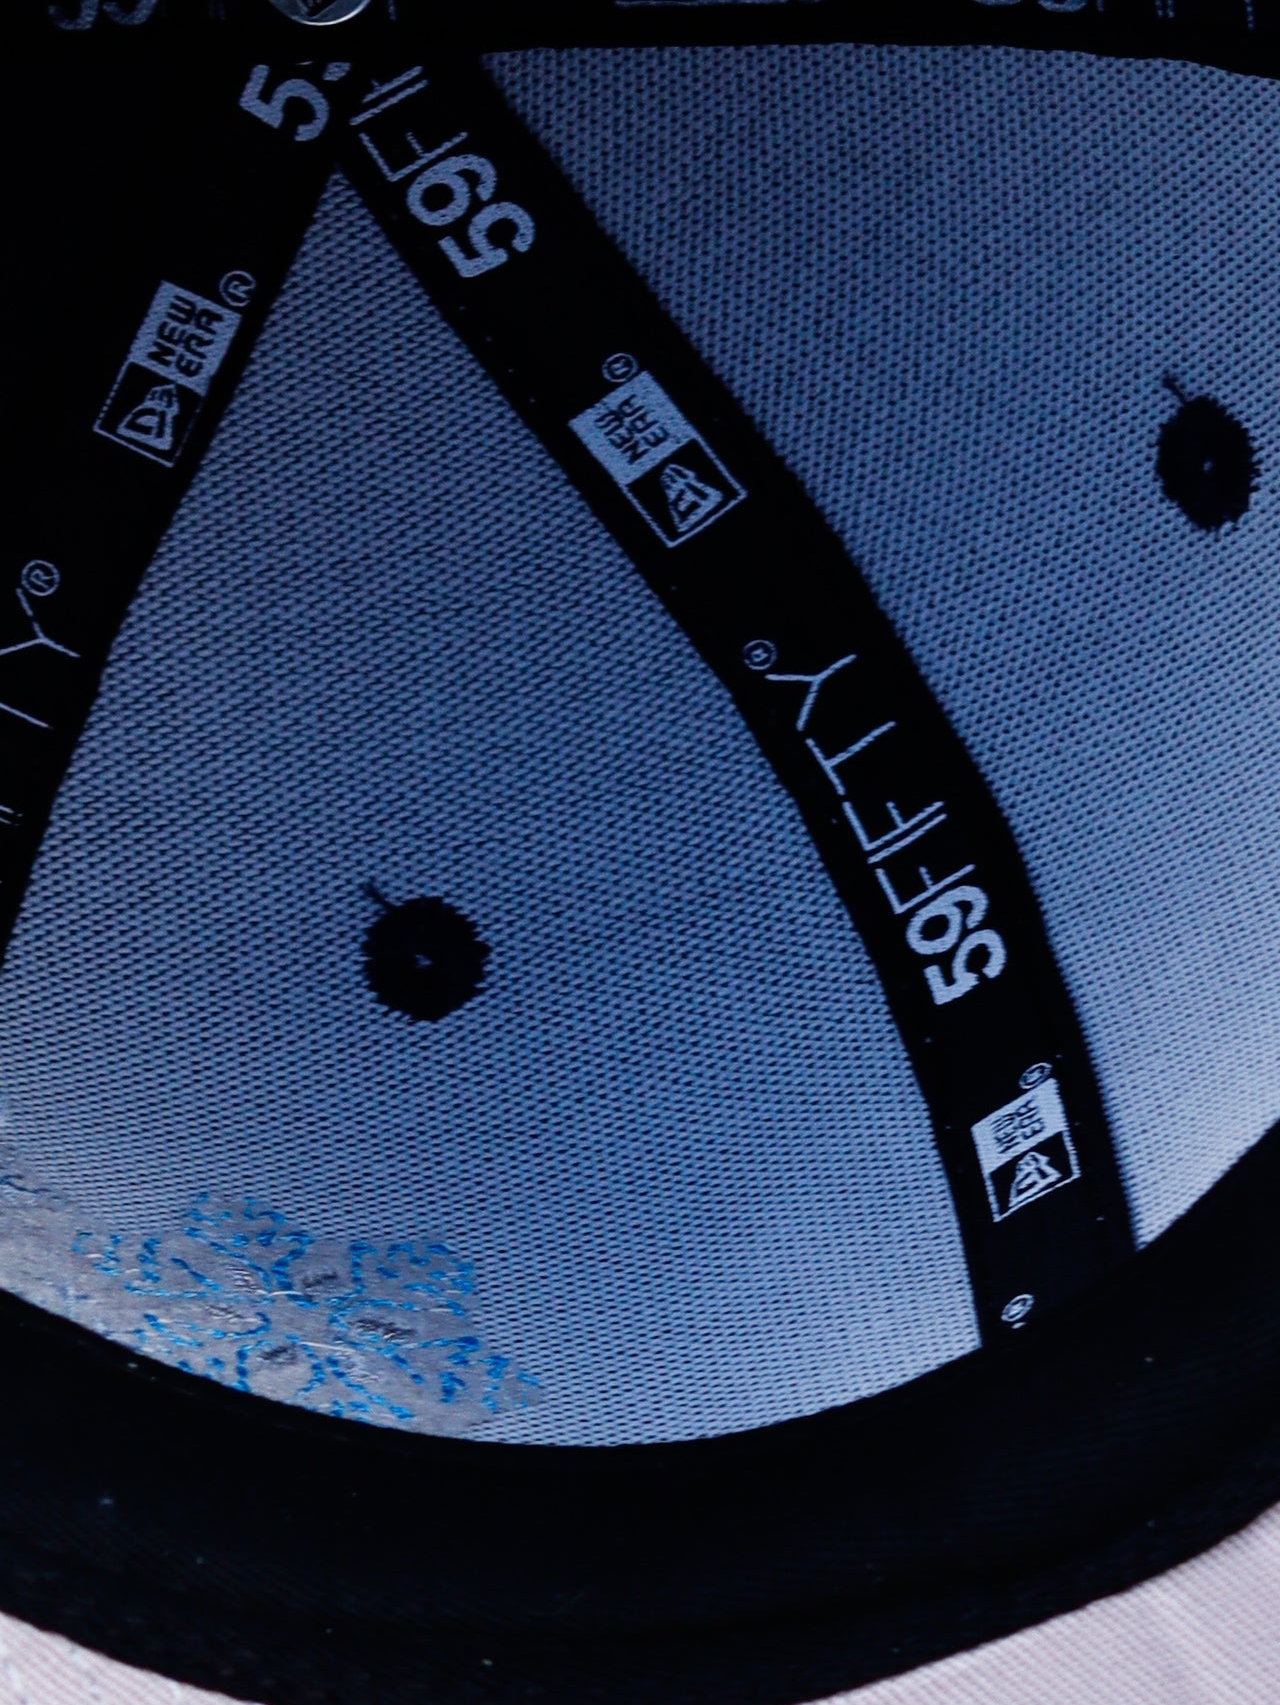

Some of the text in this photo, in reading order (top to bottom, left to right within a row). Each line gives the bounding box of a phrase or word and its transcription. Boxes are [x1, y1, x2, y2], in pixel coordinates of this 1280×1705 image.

[147, 295, 197, 368] NEW
[175, 308, 224, 378] ERA
[593, 410, 652, 465] NEW
[618, 394, 670, 447] ERA
